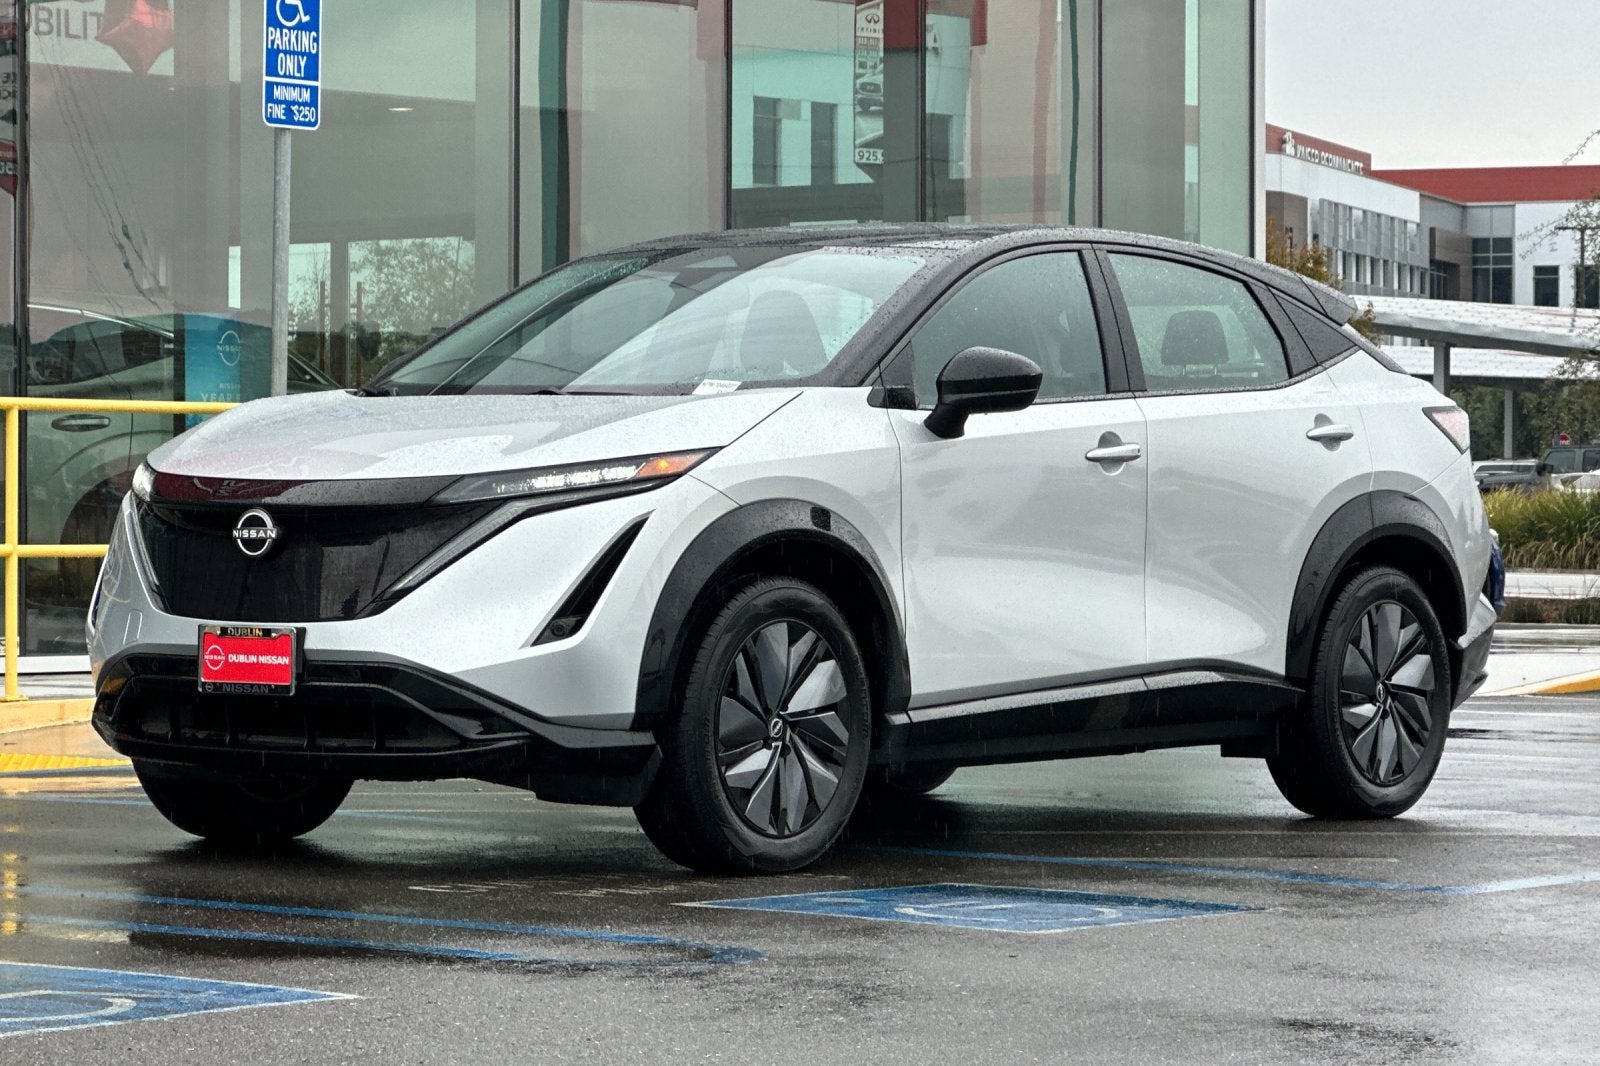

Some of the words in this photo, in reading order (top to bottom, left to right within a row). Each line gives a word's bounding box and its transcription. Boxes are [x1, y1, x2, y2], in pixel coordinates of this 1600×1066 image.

[267, 26, 318, 54] PARKING
[277, 52, 307, 78] ONLY
[273, 84, 311, 103] MINIMUM
[267, 103, 287, 120] FINE
[292, 104, 316, 122] $250
[216, 344, 242, 352] NISSA
[232, 529, 277, 539] NISSAN
[227, 627, 263, 637] DUBLIN
[228, 653, 257, 663] DUBLIN
[258, 655, 290, 665] NISSAN
[222, 683, 269, 694] NISSAN
